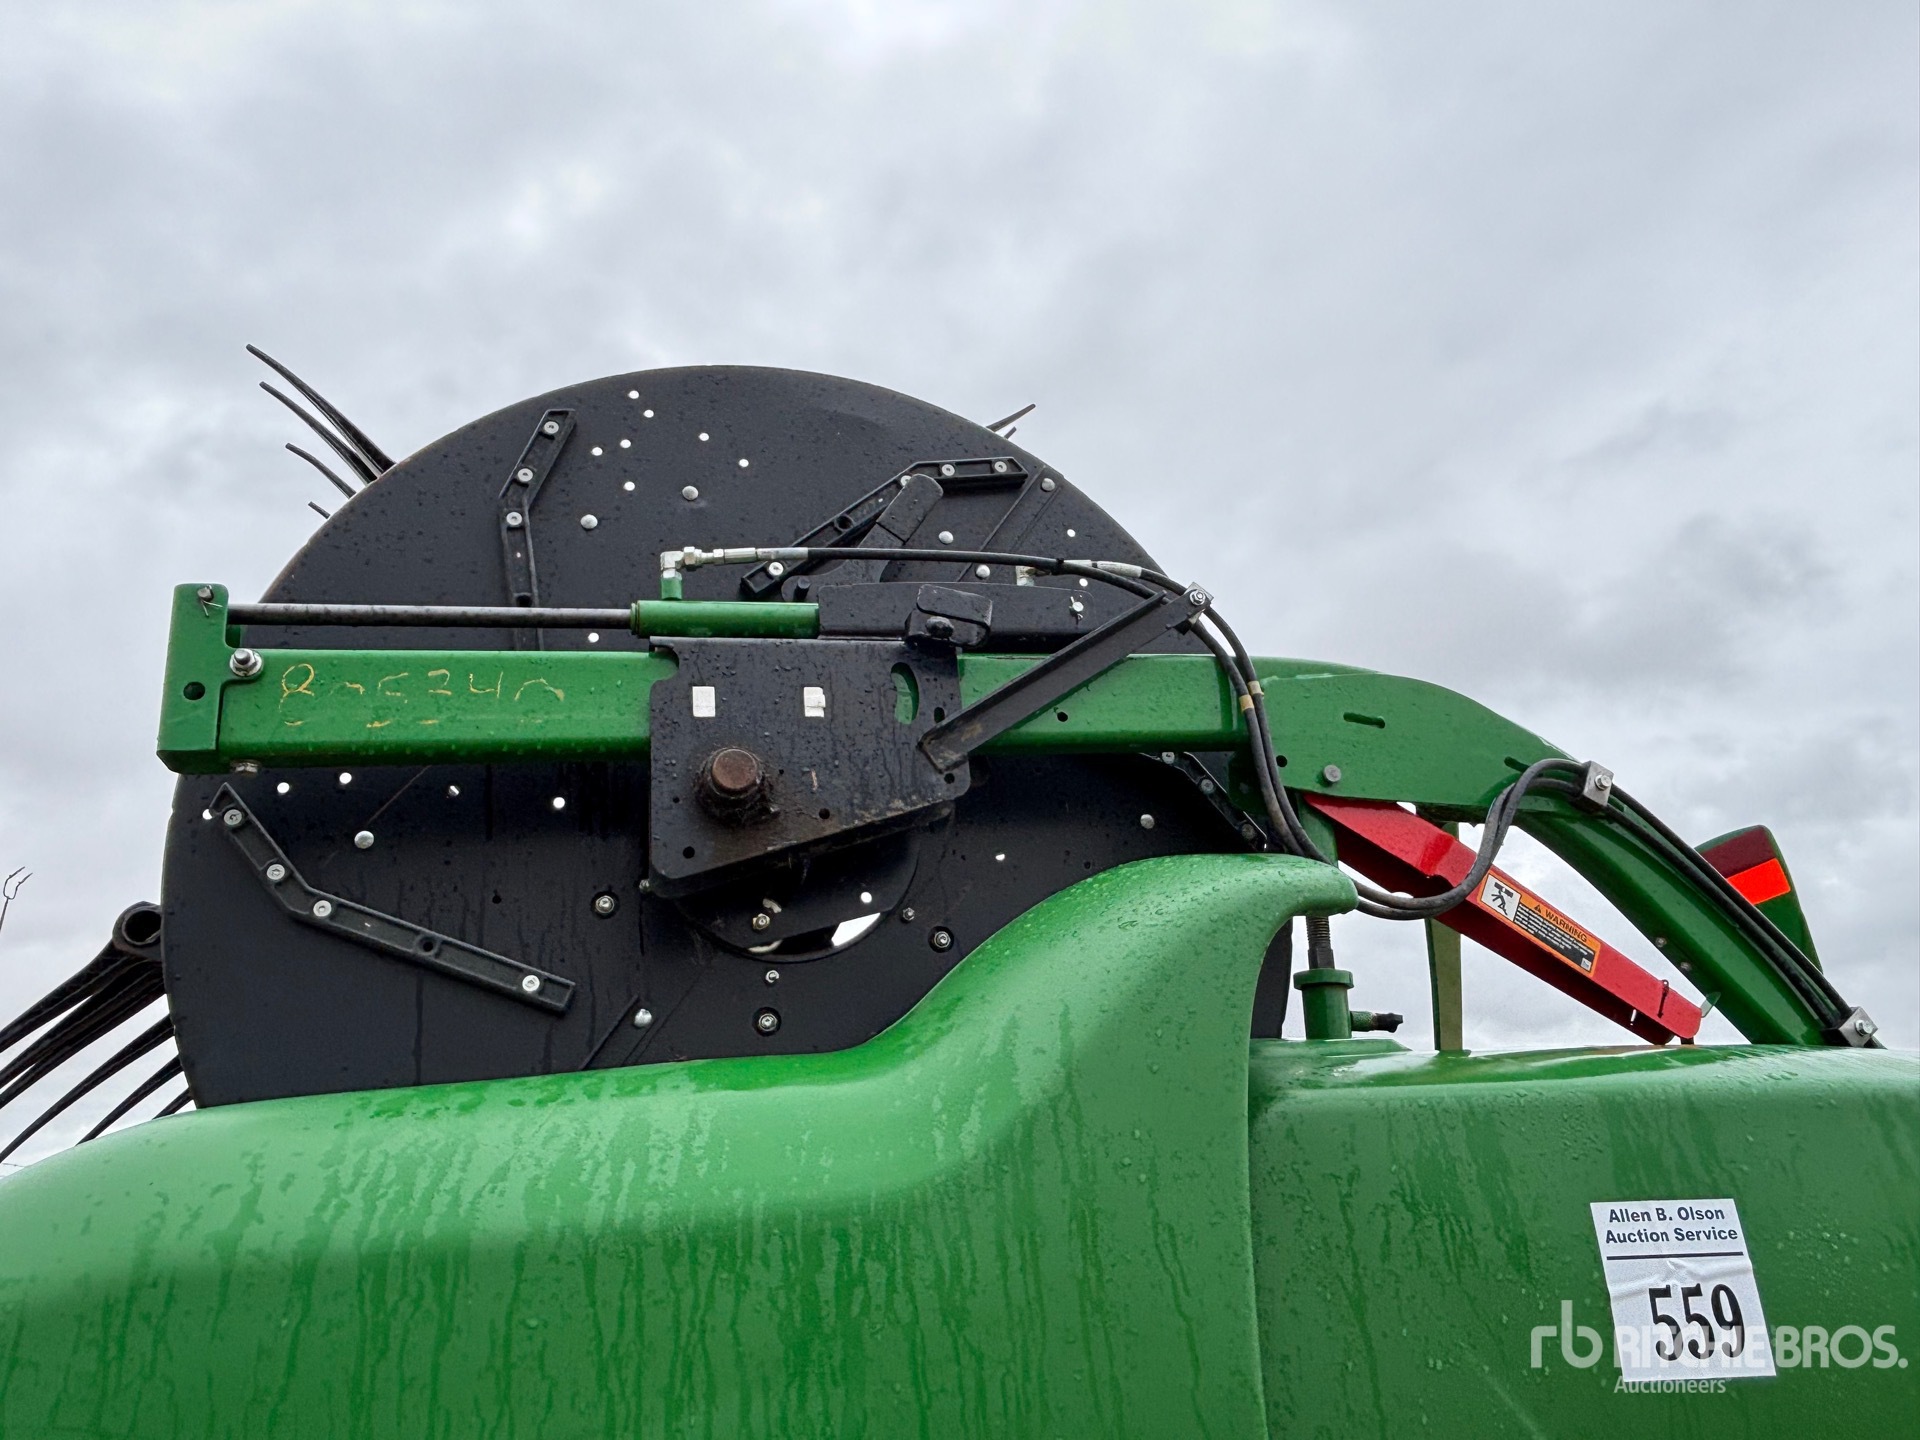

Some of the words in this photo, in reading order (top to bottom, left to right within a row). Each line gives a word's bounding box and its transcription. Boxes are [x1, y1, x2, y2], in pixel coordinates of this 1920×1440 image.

[1546, 911, 1587, 942] WARNING
[1609, 1208, 1652, 1223] Allen
[1655, 1207, 1673, 1222] B.
[1677, 1206, 1725, 1221] Olson
[1605, 1229, 1670, 1244] Auction
[1673, 1227, 1738, 1242] Service
[1648, 1283, 1746, 1362] 559
